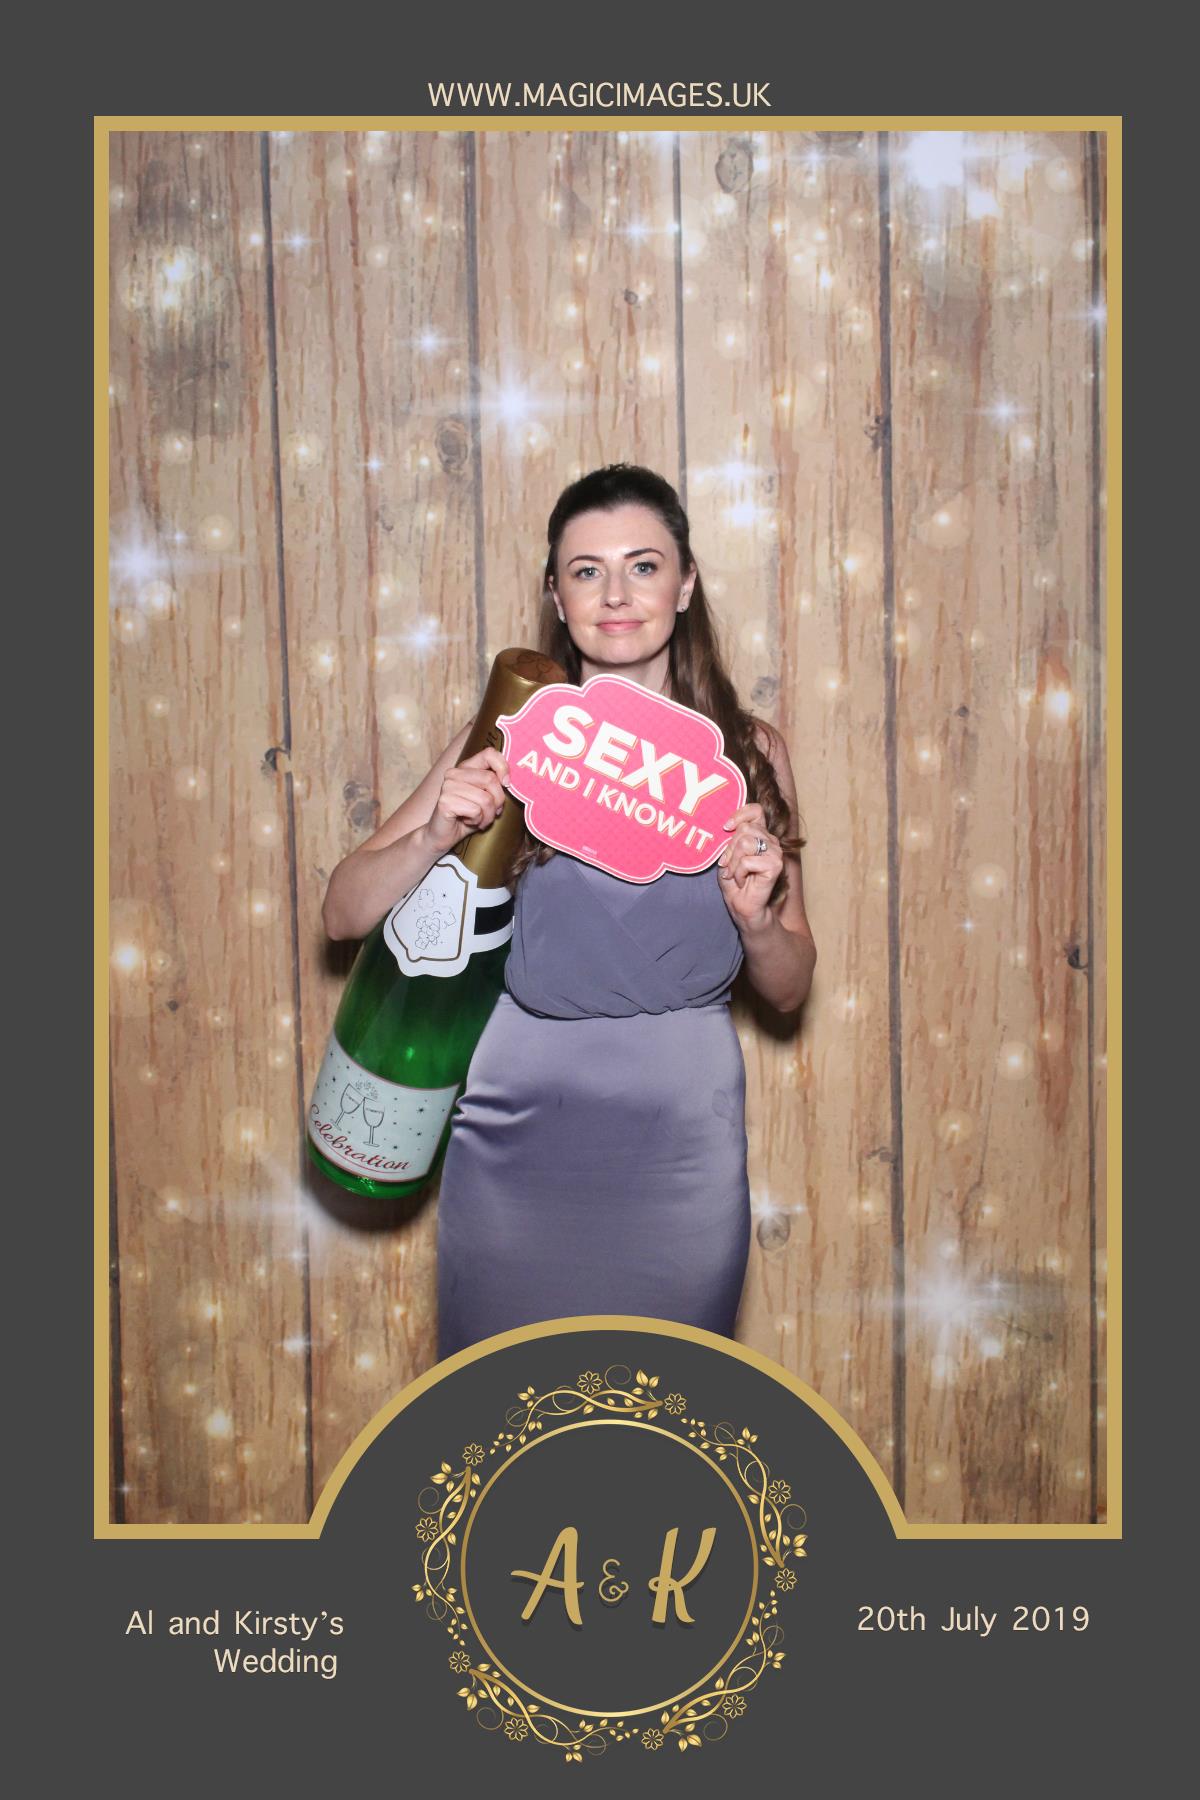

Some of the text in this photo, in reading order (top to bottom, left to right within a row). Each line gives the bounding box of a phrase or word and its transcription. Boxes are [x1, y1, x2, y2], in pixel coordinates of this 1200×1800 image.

[516, 750, 714, 851] AND I KNOW IT
[542, 705, 728, 816] SEXY
